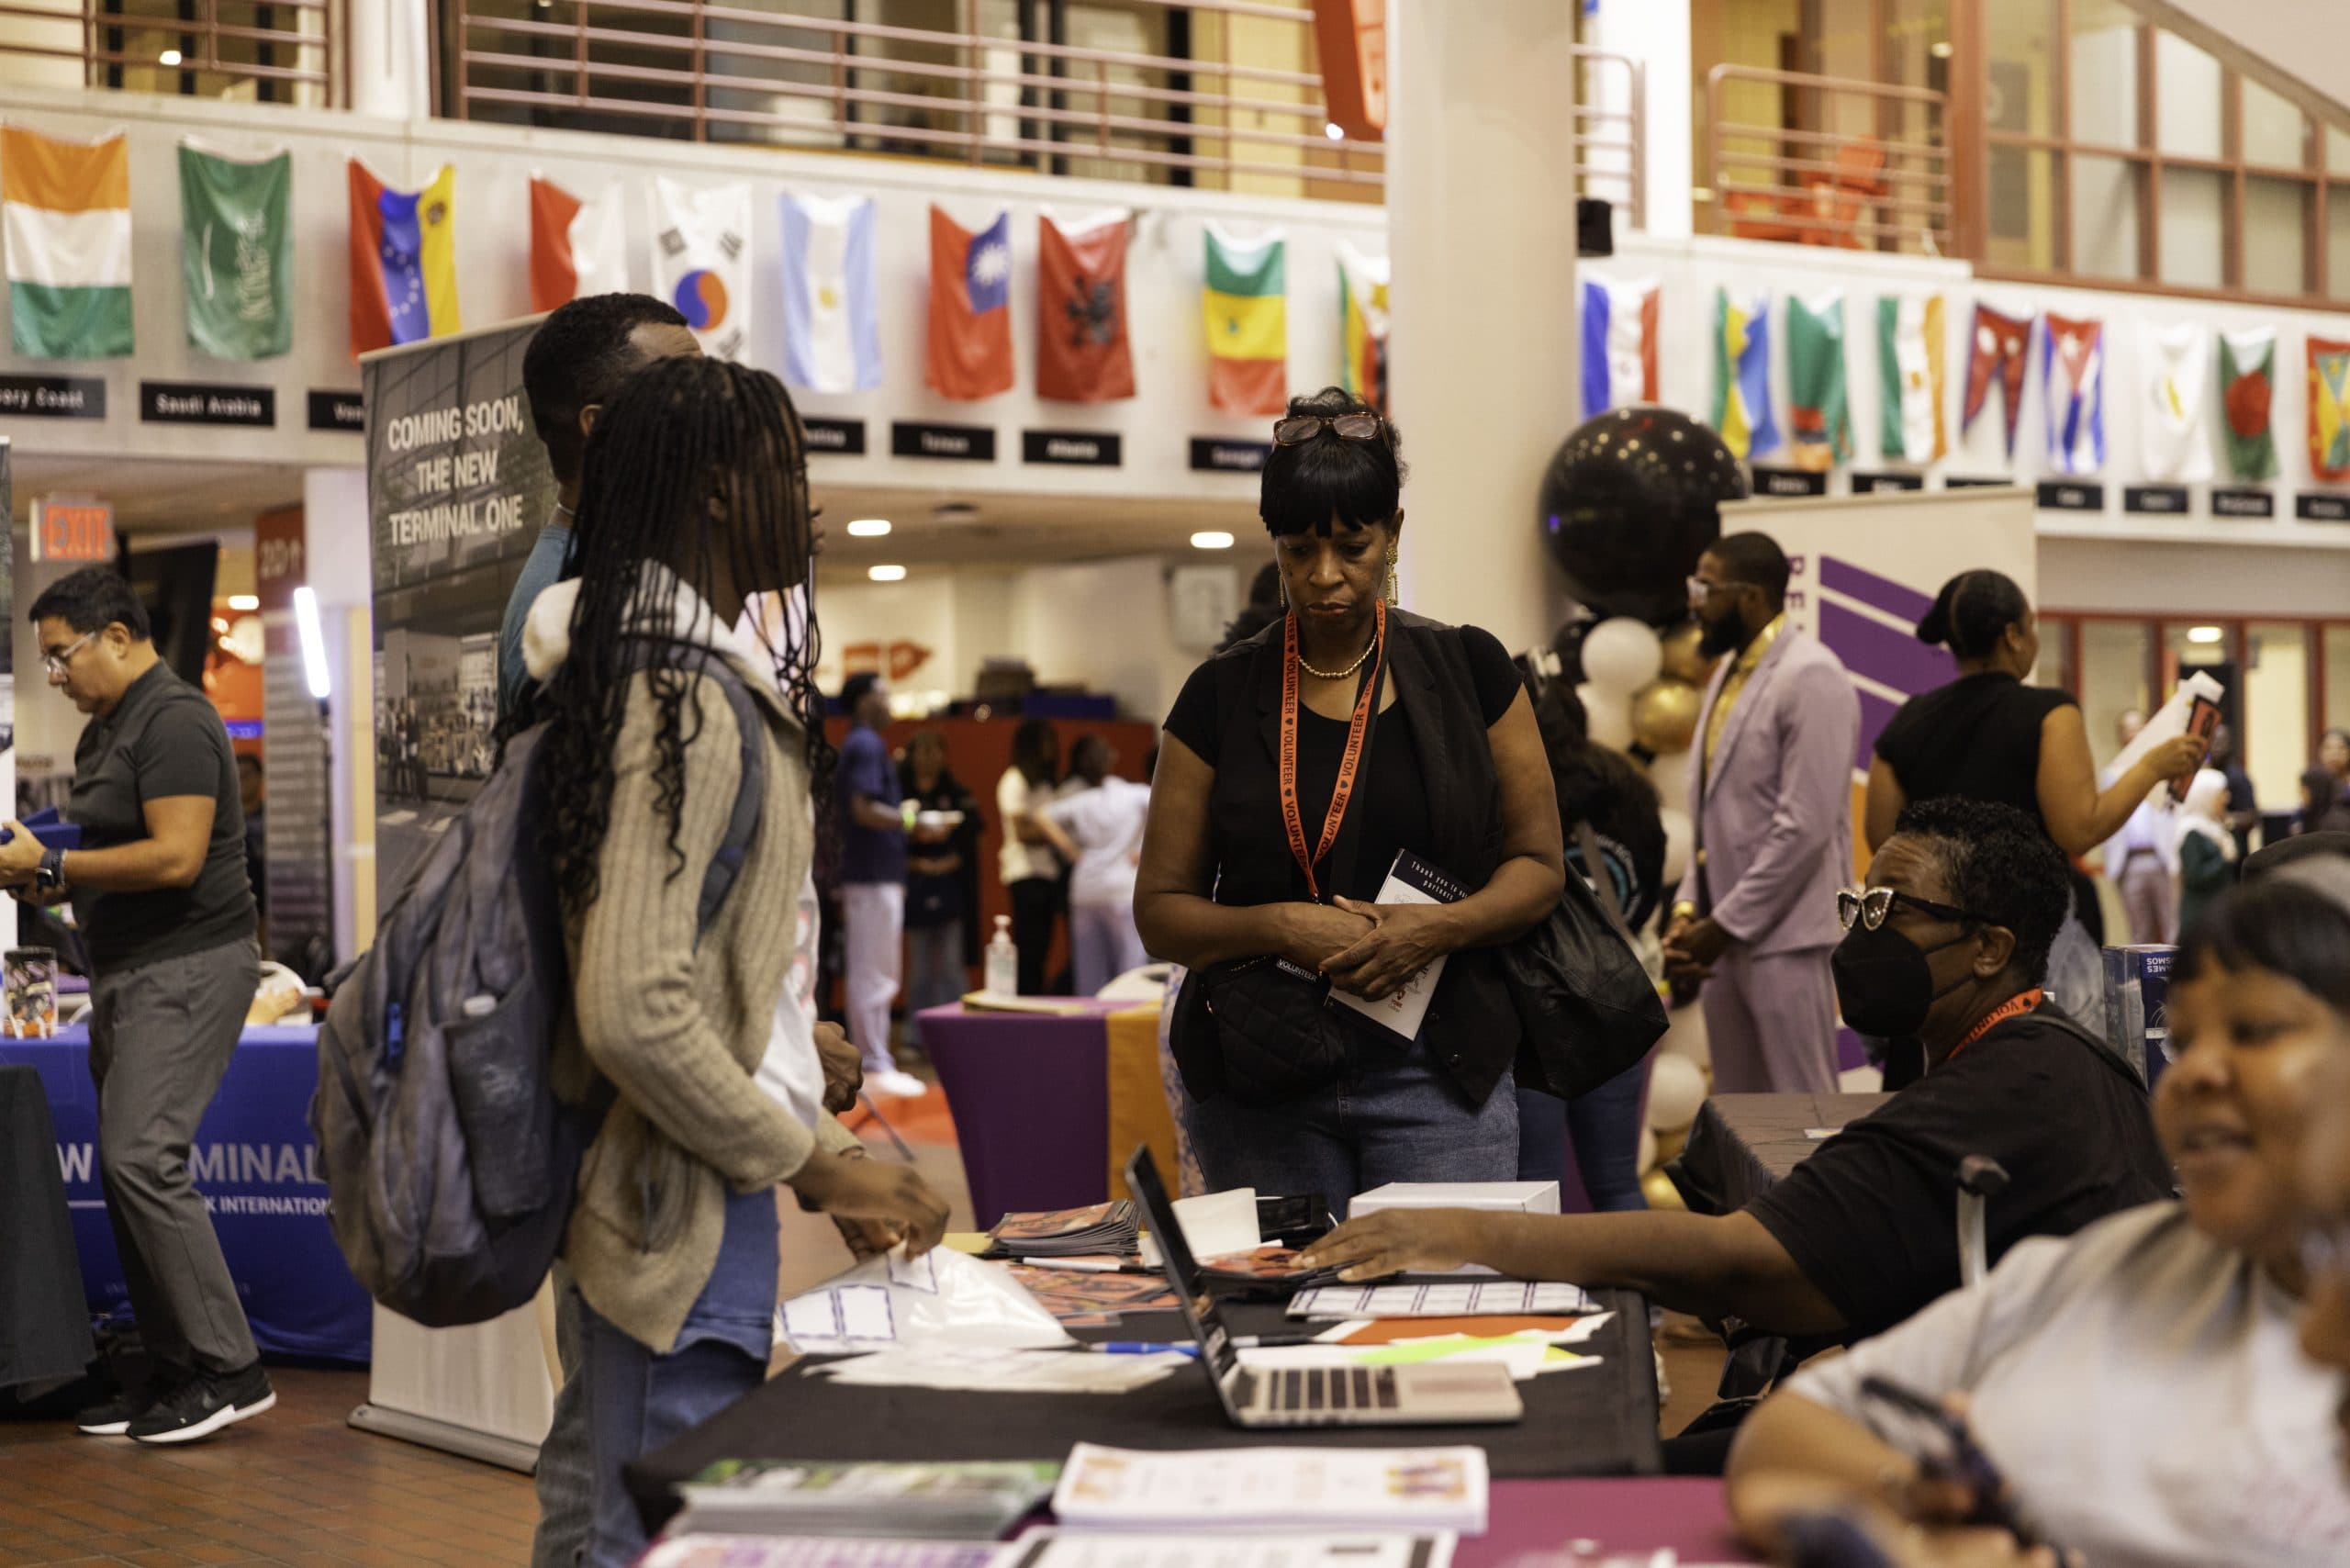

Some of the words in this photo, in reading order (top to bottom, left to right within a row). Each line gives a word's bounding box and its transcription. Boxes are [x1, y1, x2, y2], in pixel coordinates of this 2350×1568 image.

[35, 386, 84, 409] Coast
[155, 392, 204, 415] Saudi
[207, 394, 262, 417] Arabia
[387, 407, 462, 452] COMING
[464, 396, 524, 437] SOON,
[415, 456, 451, 495] THE
[453, 449, 498, 488] NEW
[47, 506, 108, 559] EXIT
[388, 501, 481, 546] TERMINAL
[486, 494, 524, 532] ONE
[1285, 655, 1296, 714] VOLUNTEER
[1283, 729, 1293, 786] VOLUNTEER
[1342, 713, 1364, 777] VOLUNTEER
[1411, 861, 1433, 879] Thank
[1435, 877, 1449, 887] you
[1423, 879, 1454, 901] partners
[1277, 958, 1318, 982] VOLUNTEER
[188, 1144, 328, 1184] MINAL
[219, 1196, 333, 1215] INTERNATION
